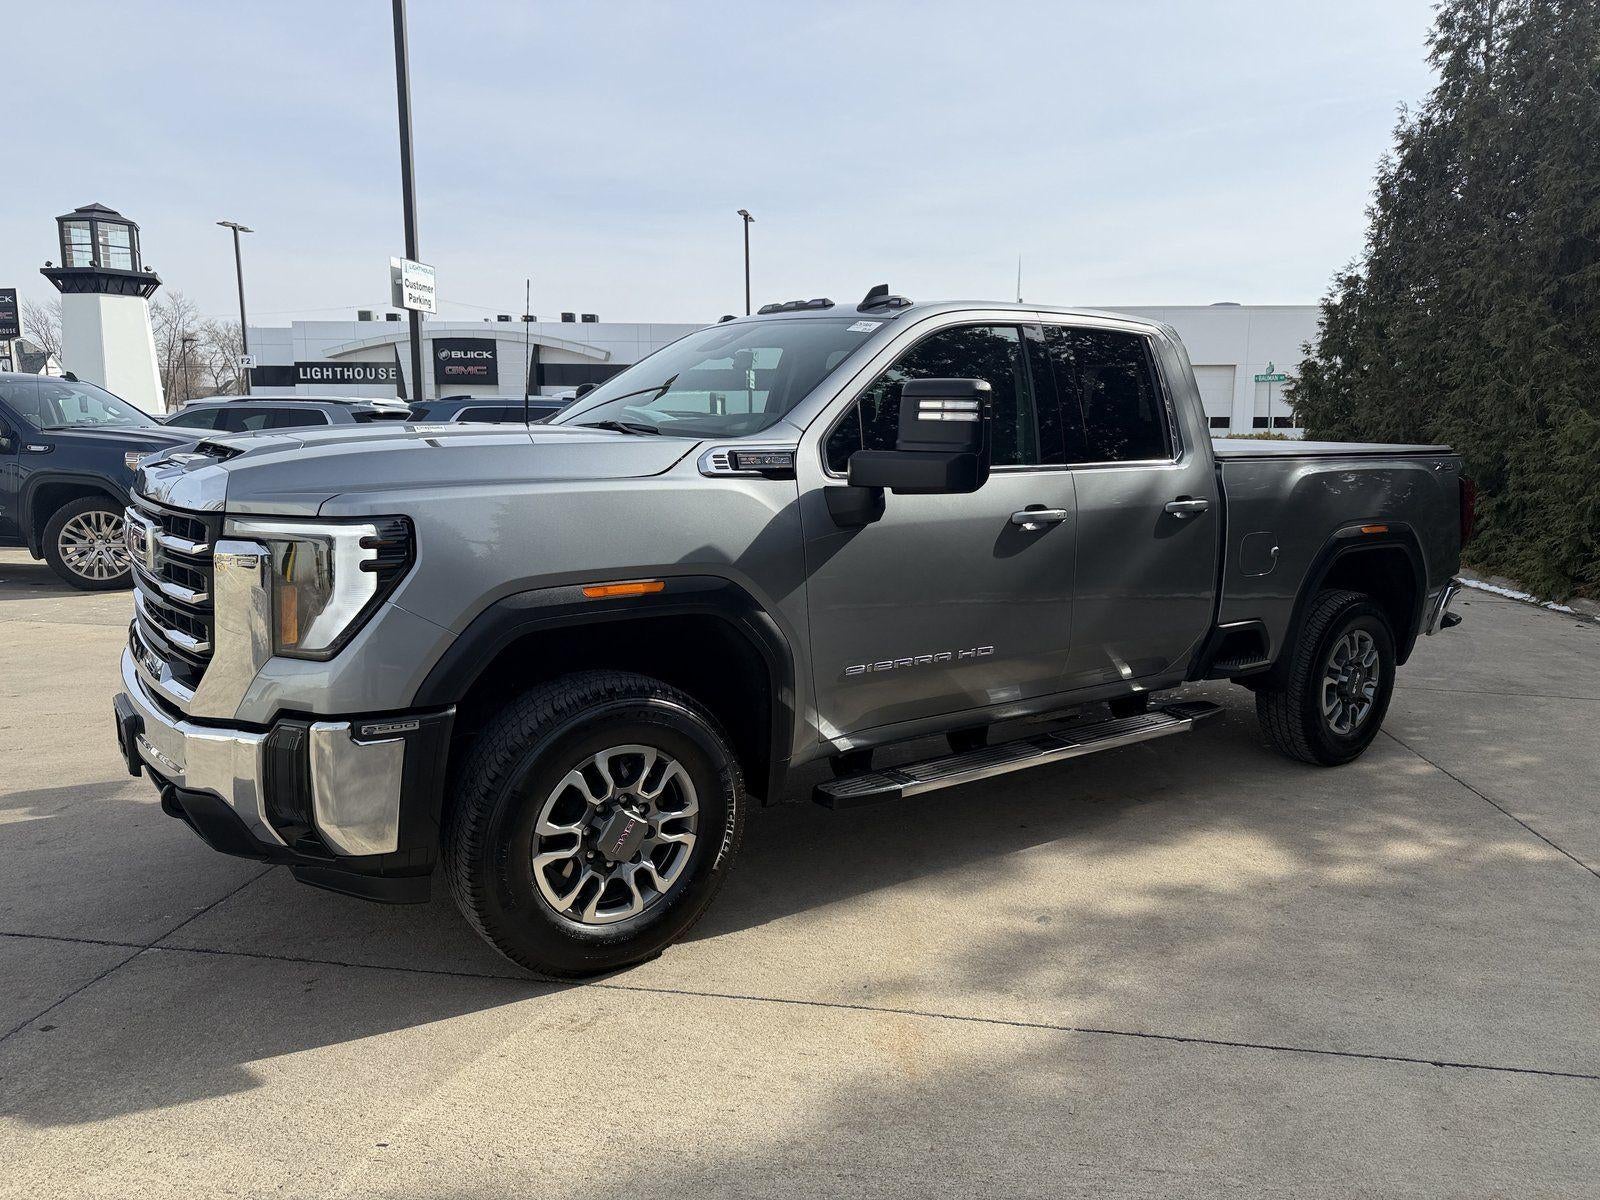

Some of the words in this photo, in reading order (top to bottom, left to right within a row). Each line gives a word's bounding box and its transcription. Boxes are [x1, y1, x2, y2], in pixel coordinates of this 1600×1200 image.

[404, 278, 434, 293] Customer
[408, 292, 432, 309] Parking
[241, 357, 251, 365] F2
[451, 350, 493, 359] BUICK
[299, 366, 397, 380] LIGHTHOUSE
[444, 365, 487, 375] GMC
[845, 651, 952, 677] SIERRA
[957, 645, 995, 661] HD
[611, 818, 636, 855] GMC
